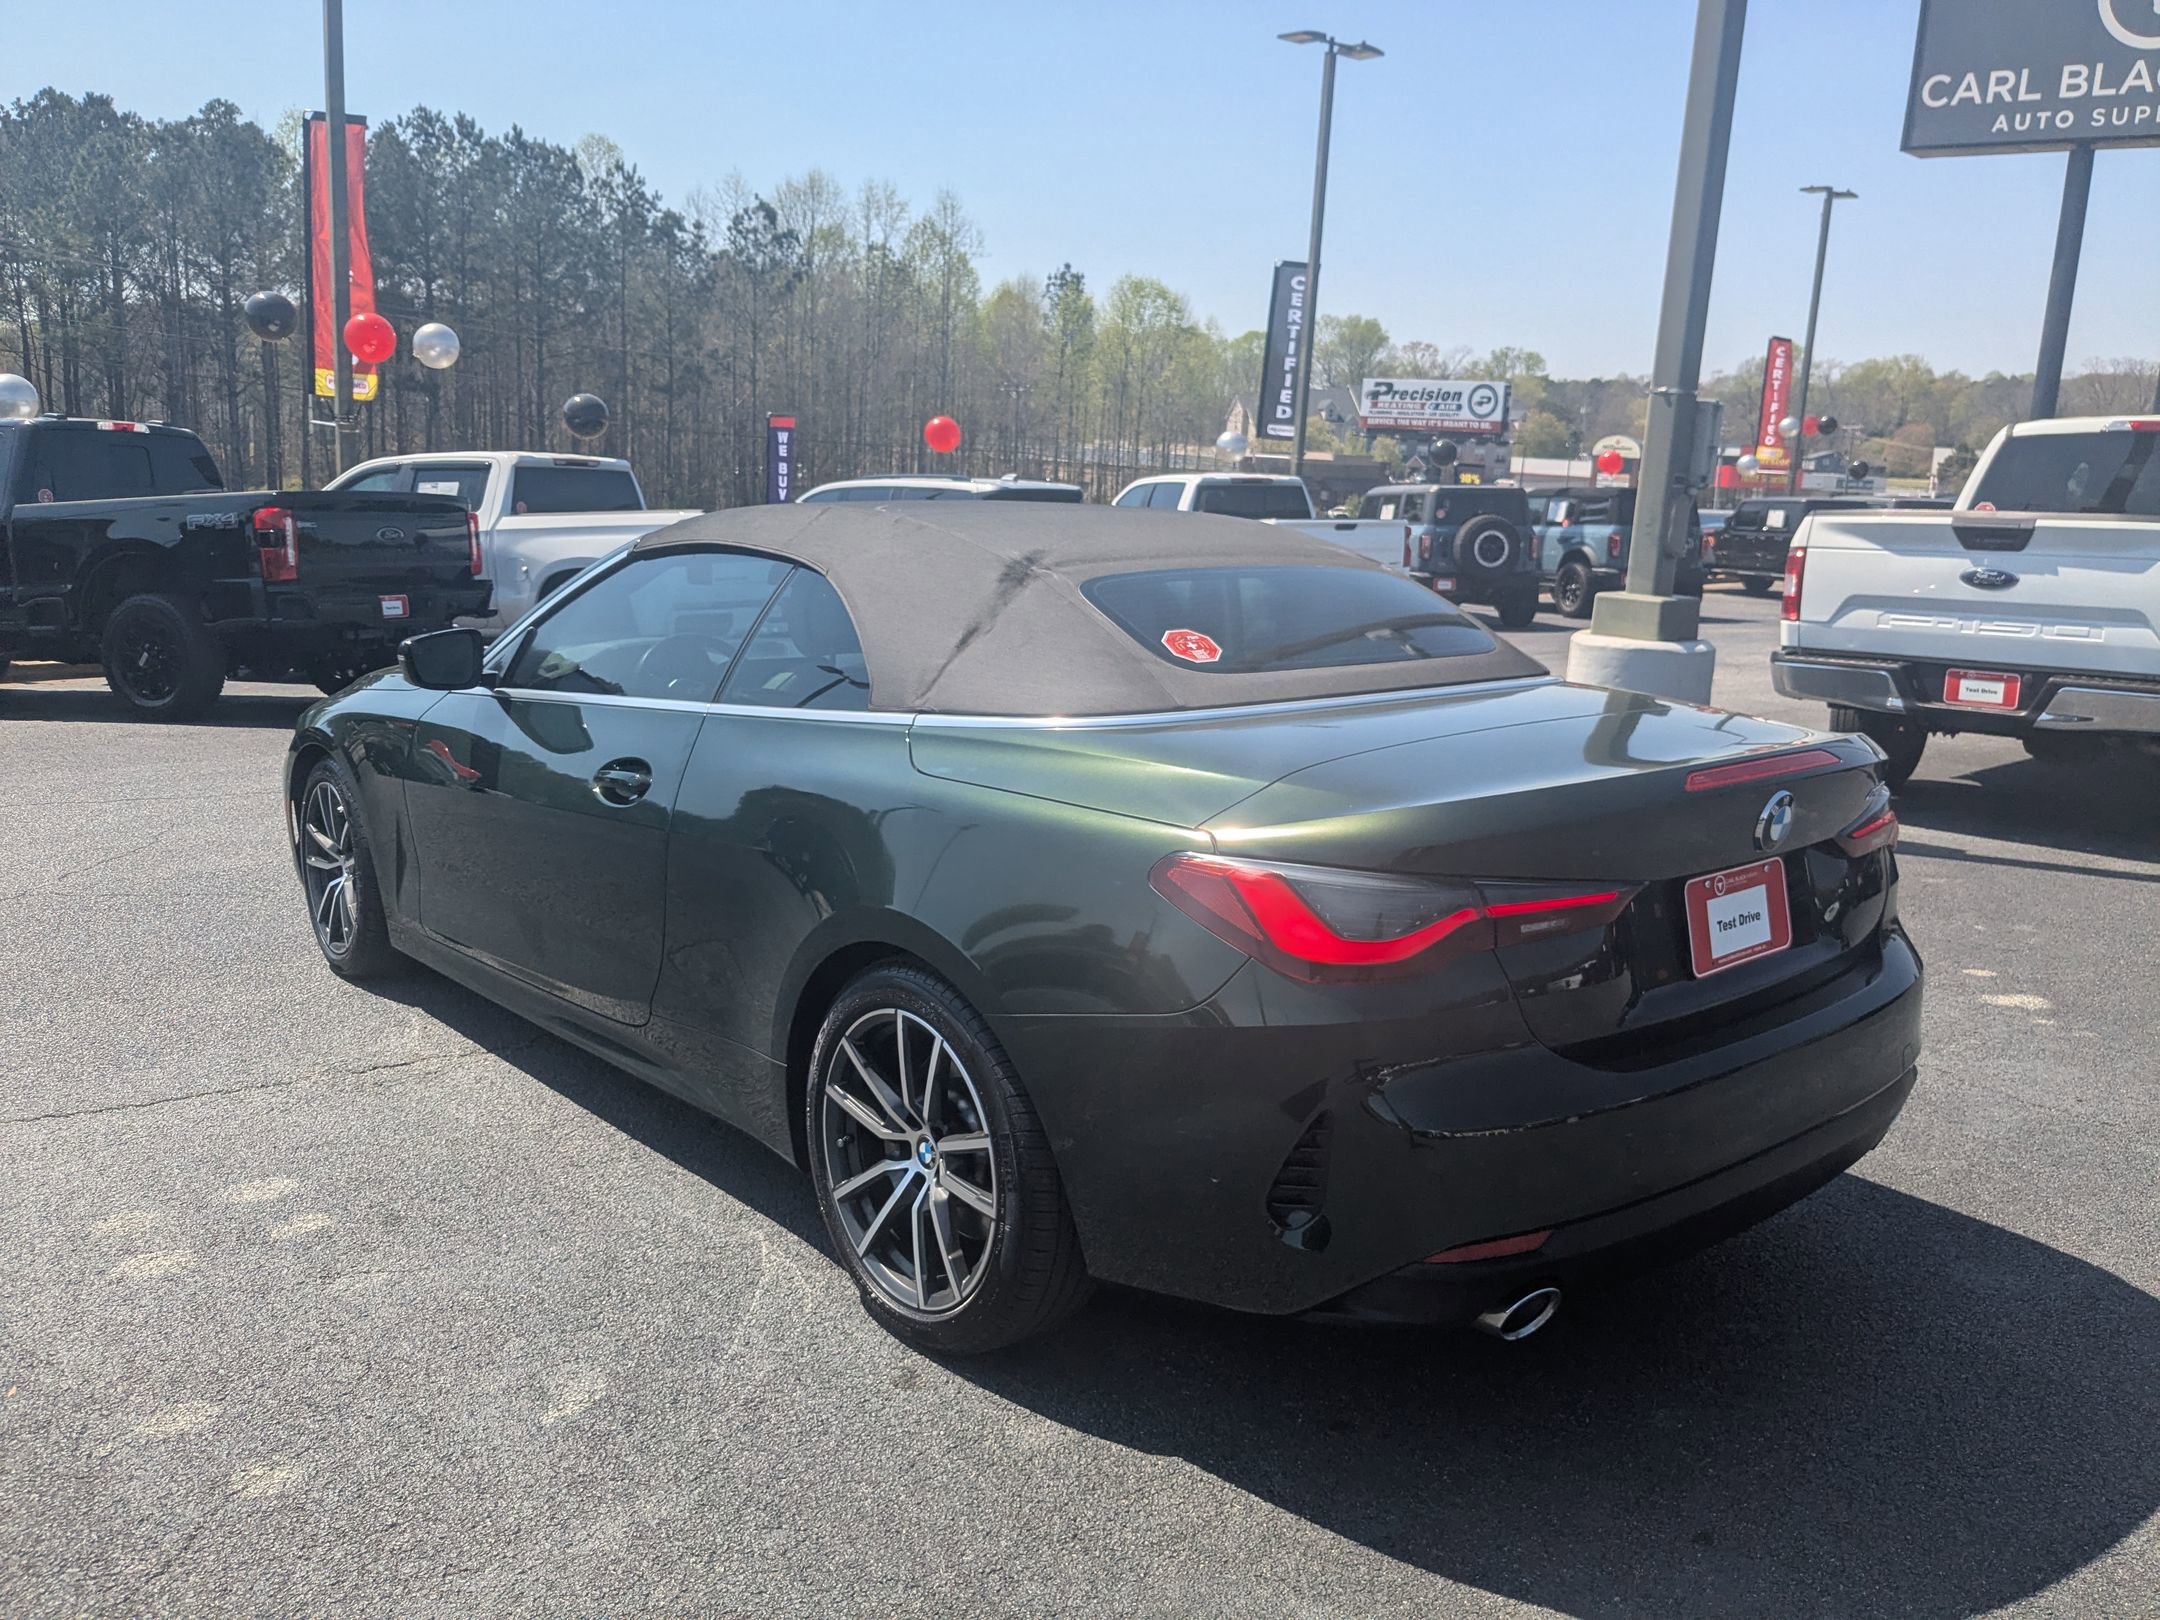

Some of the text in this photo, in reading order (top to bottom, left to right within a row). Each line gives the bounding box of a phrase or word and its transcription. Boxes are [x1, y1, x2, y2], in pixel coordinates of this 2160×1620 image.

[1921, 59, 2160, 108] CARL BLA
[1991, 110, 2075, 132] AUTO
[1275, 276, 1306, 419] CERTIFIED
[1365, 382, 1463, 402] Precision
[1764, 346, 1787, 446] CERTIFIED
[1377, 402, 1421, 410] HEATING
[777, 431, 789, 456] WE
[1876, 612, 2105, 643] F-150
[1965, 686, 1998, 696] Test Drive
[1717, 911, 1761, 933] Test Drive
